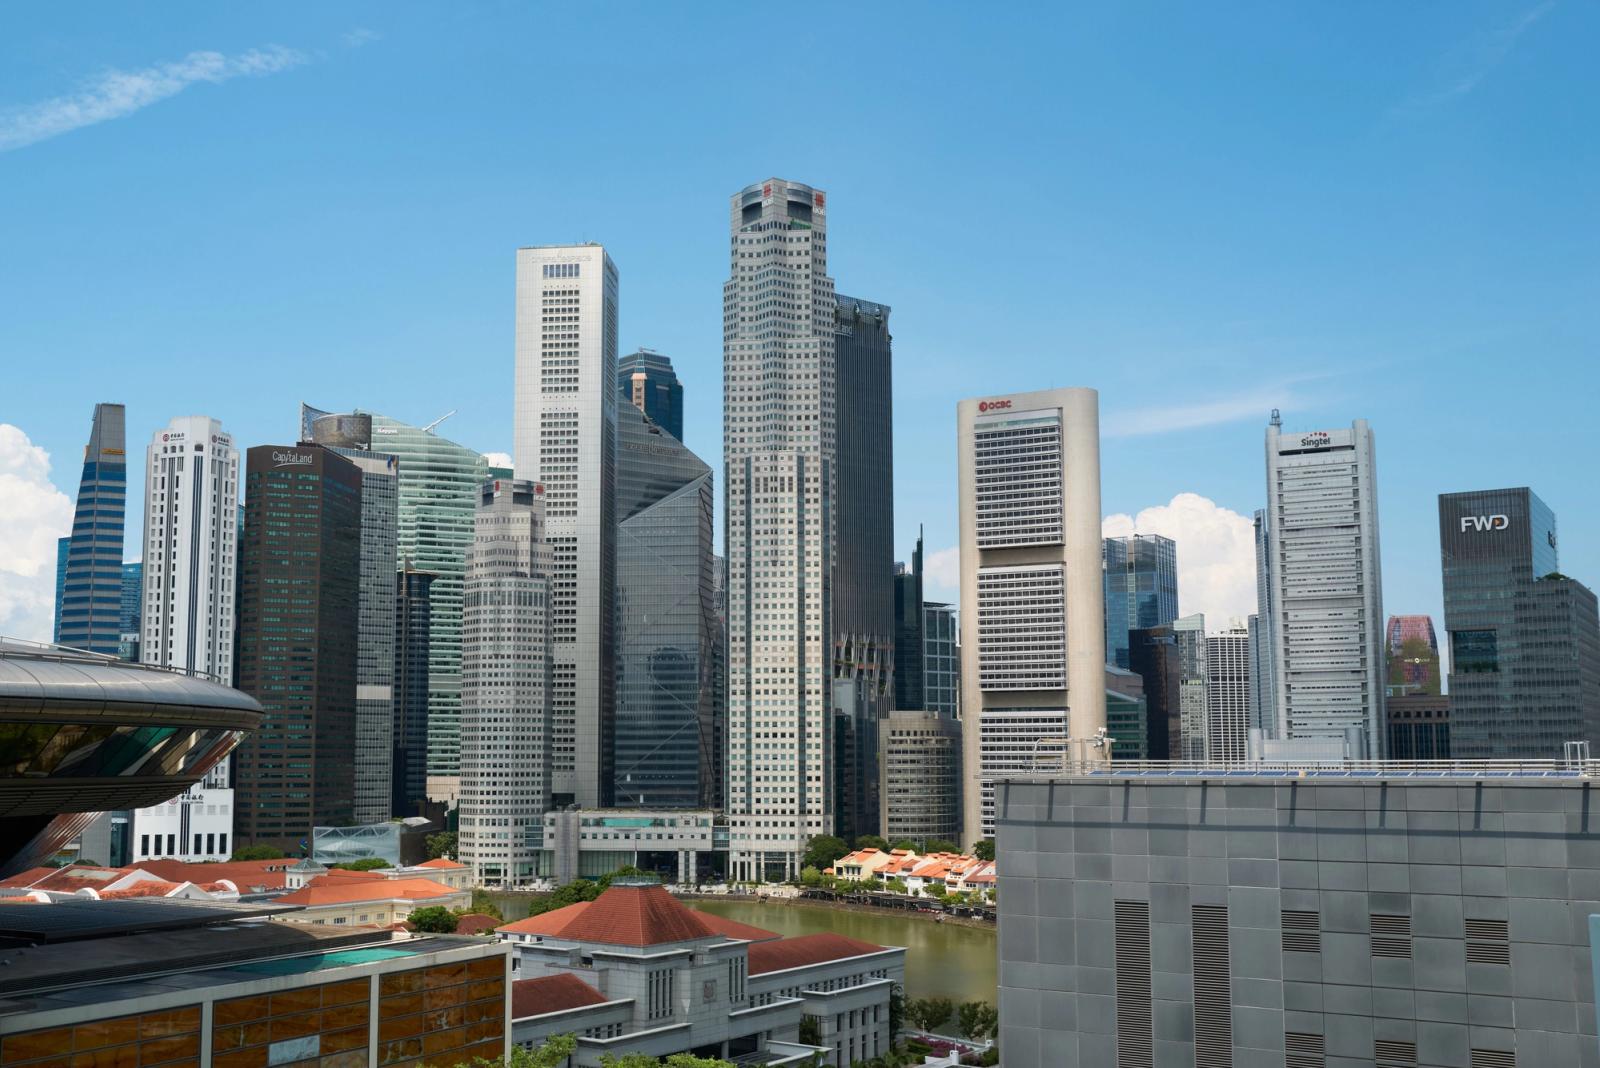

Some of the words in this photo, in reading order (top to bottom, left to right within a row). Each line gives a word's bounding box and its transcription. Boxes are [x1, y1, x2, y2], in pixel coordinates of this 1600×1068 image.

[989, 400, 1011, 410] OCBC
[1301, 437, 1330, 448] Singtel
[272, 450, 313, 464] CapitaLand
[1461, 514, 1509, 532] FWD
